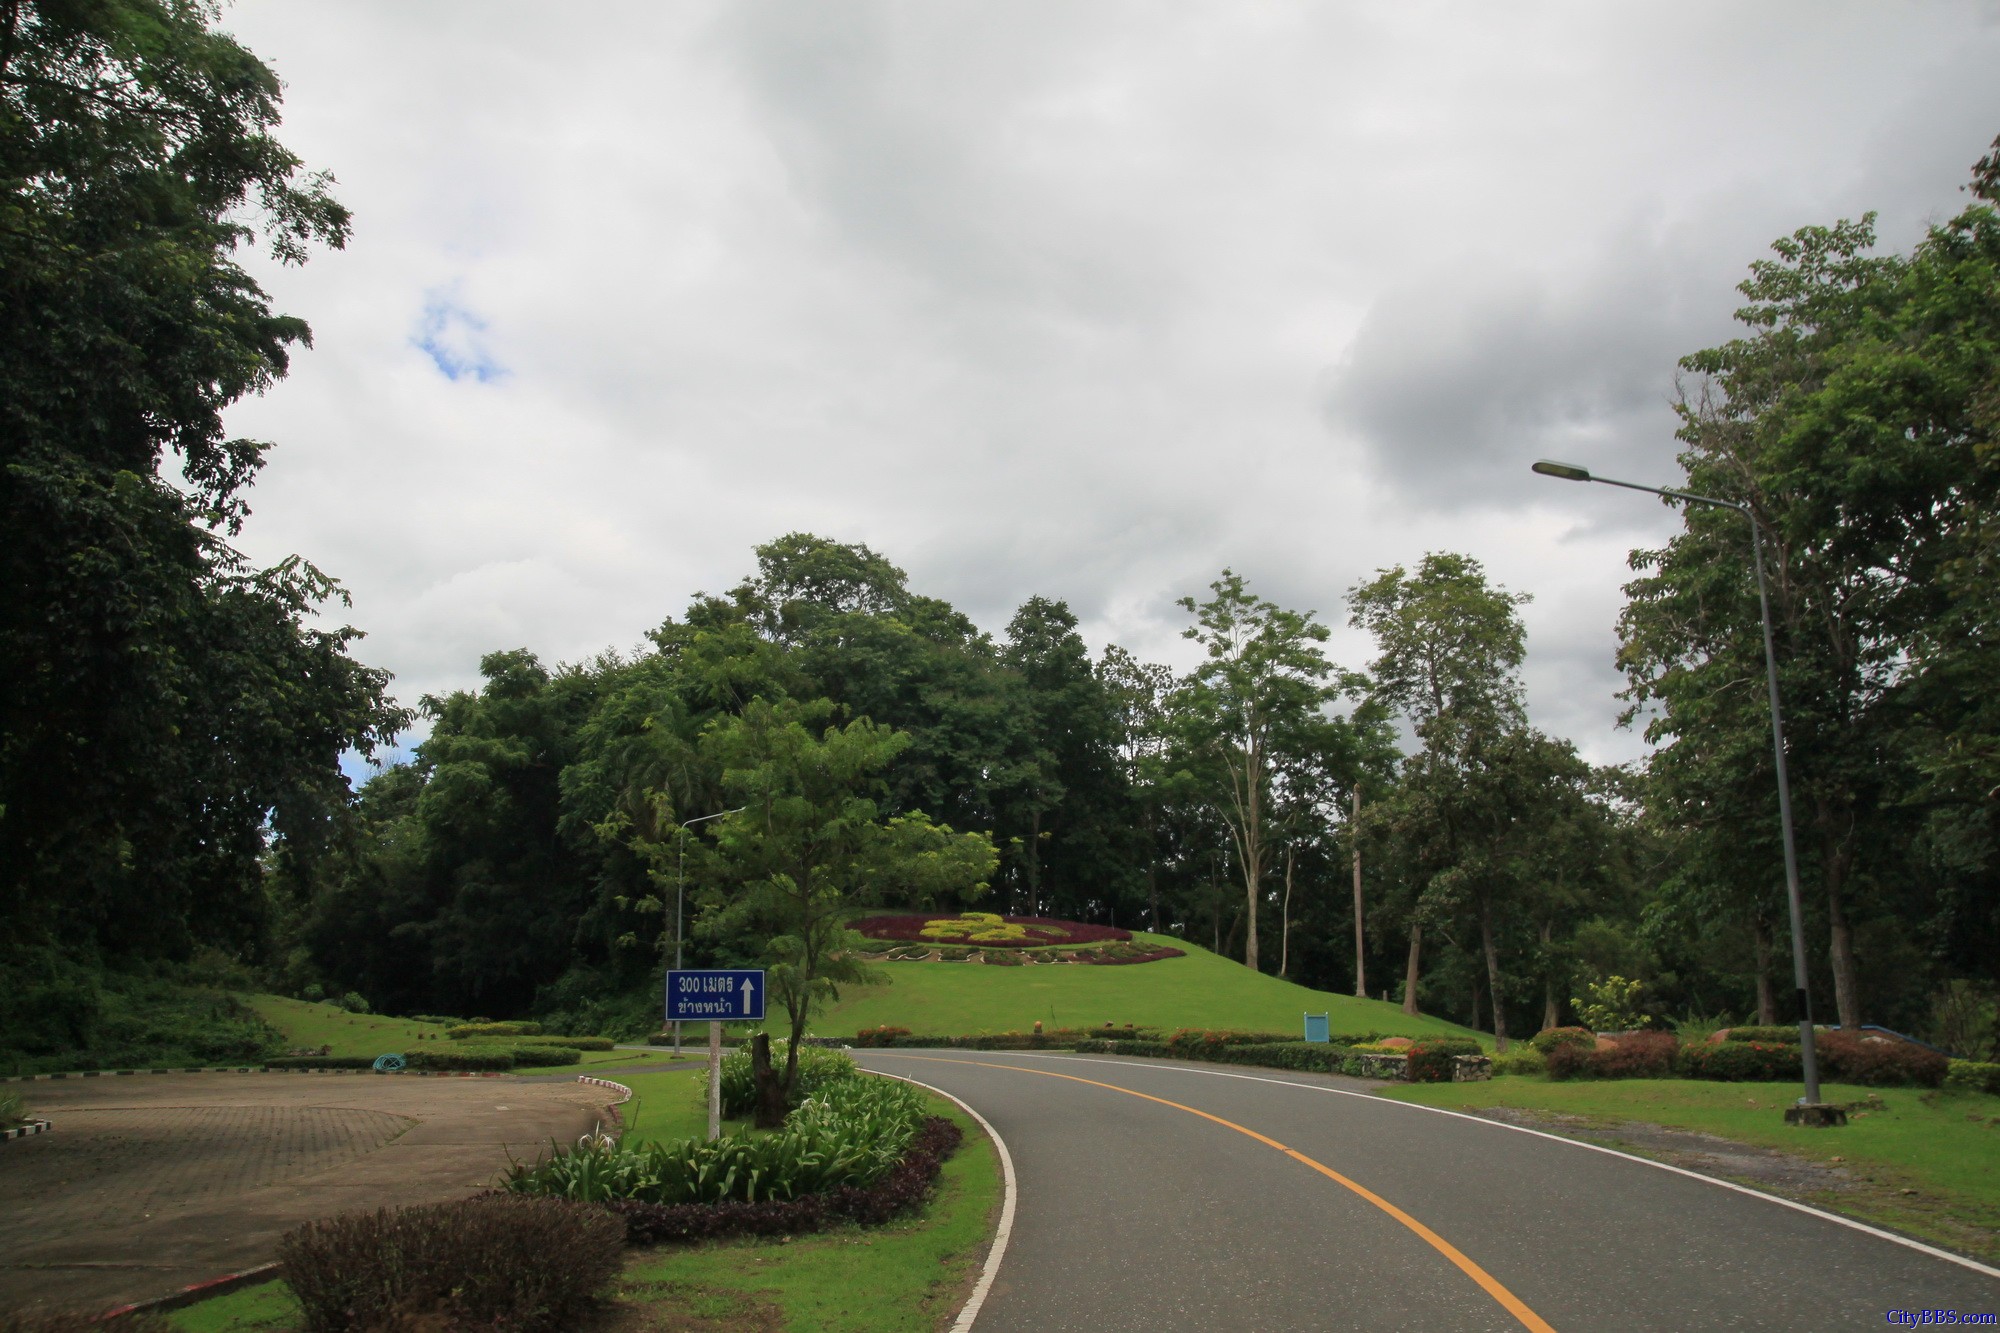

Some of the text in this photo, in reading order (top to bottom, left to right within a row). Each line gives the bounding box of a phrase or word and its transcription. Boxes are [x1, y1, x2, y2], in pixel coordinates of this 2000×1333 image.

[679, 976, 733, 993] 300 เมตร
[678, 997, 732, 1013] ข้างหน้า
